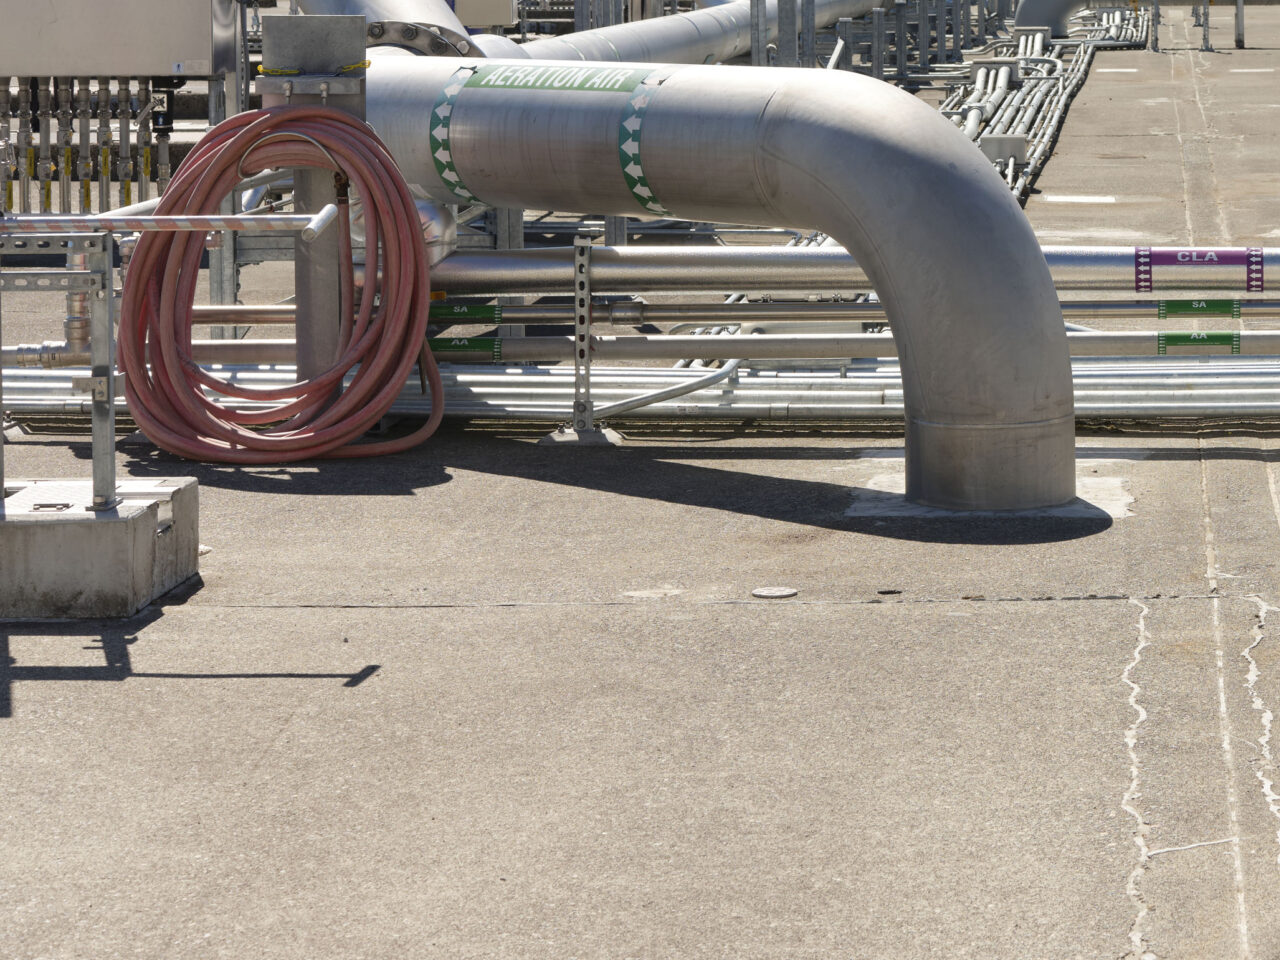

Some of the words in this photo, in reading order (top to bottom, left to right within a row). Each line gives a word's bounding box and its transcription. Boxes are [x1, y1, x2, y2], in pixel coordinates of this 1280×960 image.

[480, 66, 594, 88] AERATION
[584, 69, 635, 89] AIR
[1177, 251, 1219, 262] CLA
